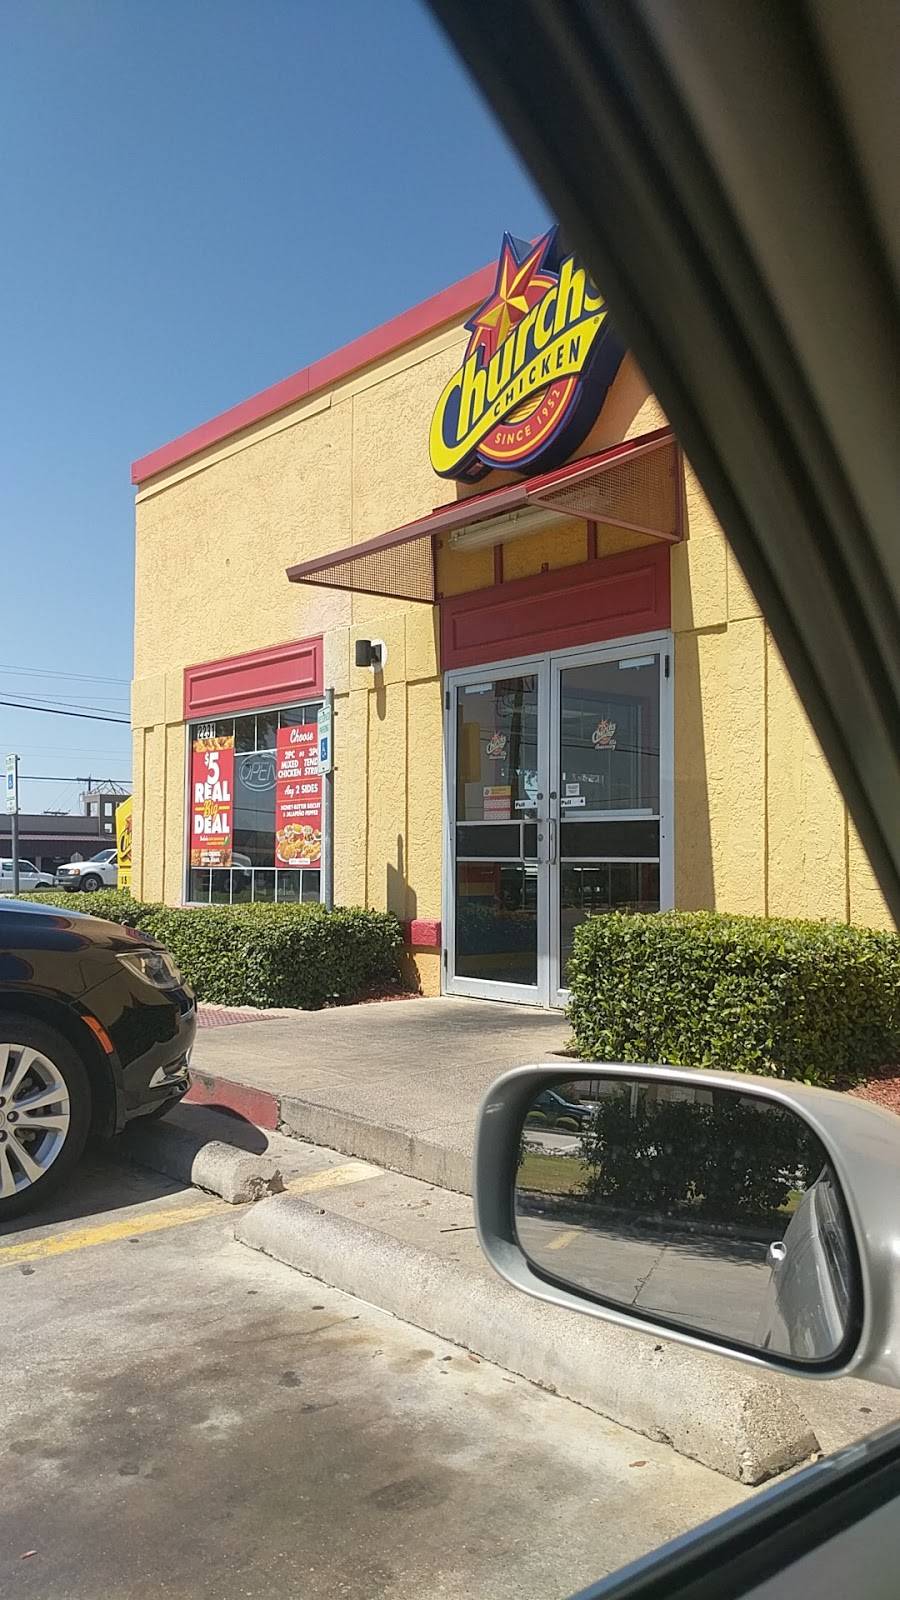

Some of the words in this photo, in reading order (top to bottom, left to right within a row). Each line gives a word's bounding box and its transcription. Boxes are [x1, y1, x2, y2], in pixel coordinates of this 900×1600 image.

[492, 335, 580, 417] CHICKEN
[494, 425, 532, 444] SINCE
[536, 389, 561, 425] 1952
[198, 724, 215, 739] 2231
[289, 728, 314, 743] Choose
[204, 752, 220, 785] $5
[242, 762, 277, 781] OPEN
[278, 768, 301, 778] CHICKEN
[281, 760, 298, 769] MIXED
[195, 780, 230, 803] REAL
[296, 784, 300, 795] 2
[301, 783, 318, 794] SIDES
[203, 799, 219, 818] Big
[194, 814, 230, 834] DEAL
